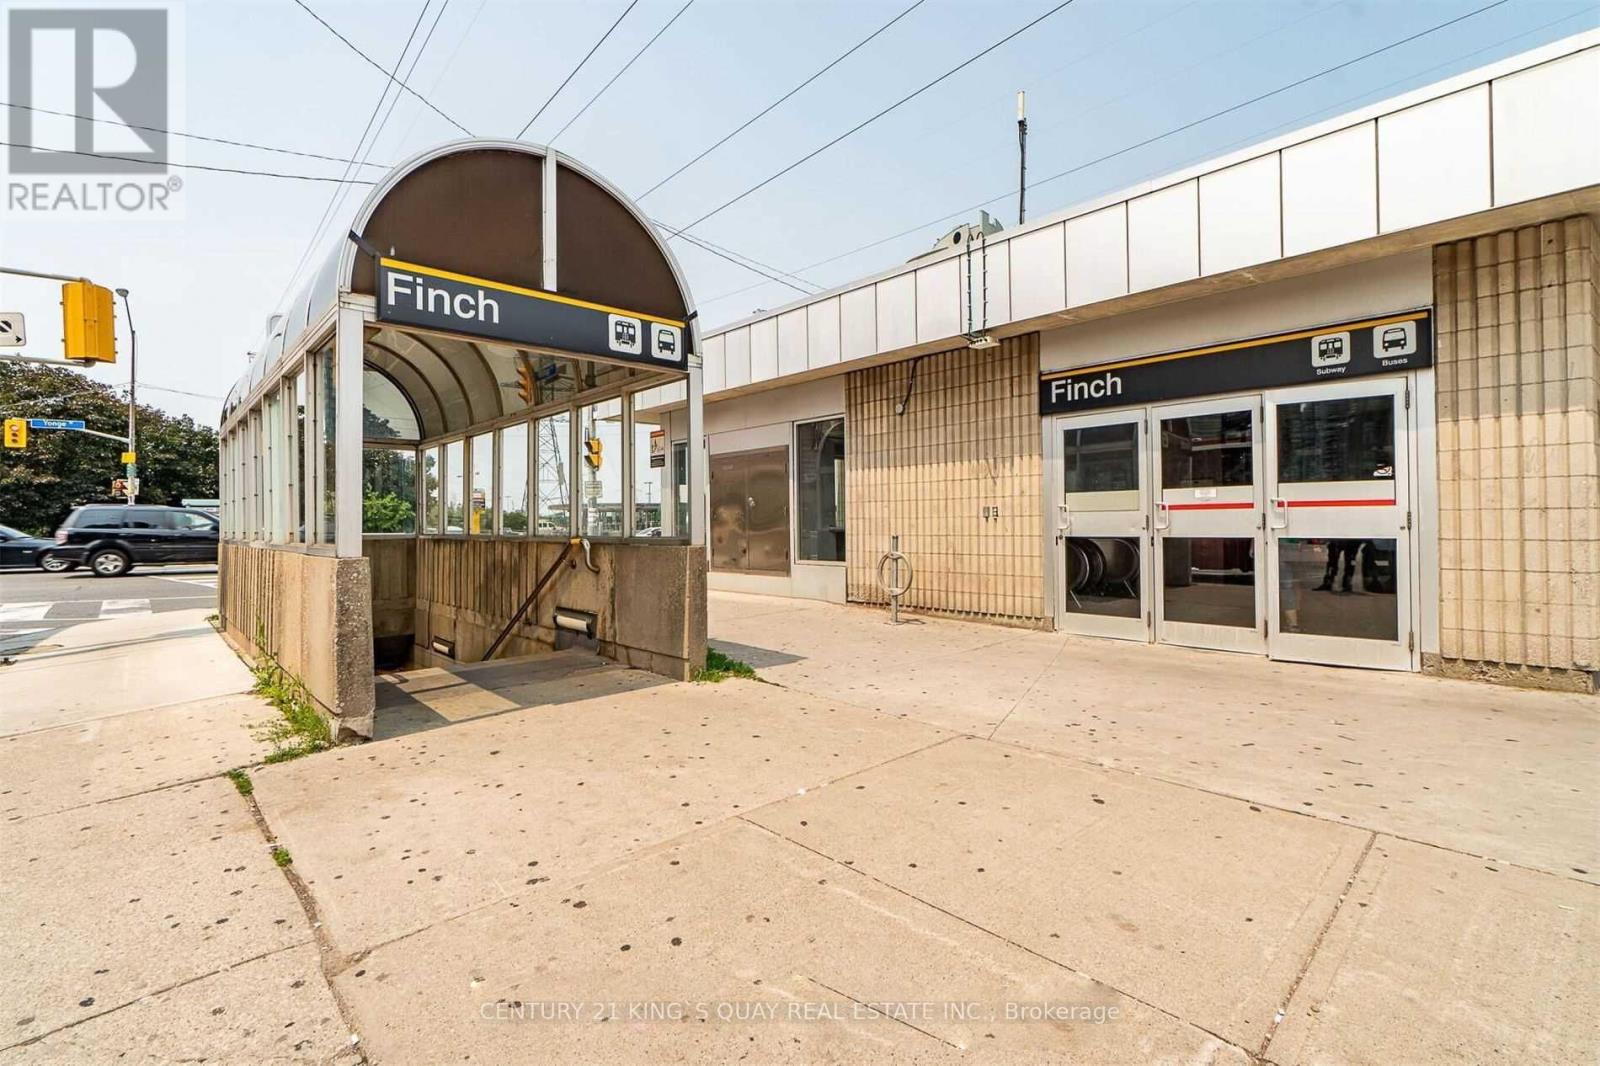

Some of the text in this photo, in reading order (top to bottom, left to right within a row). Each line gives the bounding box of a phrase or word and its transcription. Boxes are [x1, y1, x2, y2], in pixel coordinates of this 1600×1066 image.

[387, 271, 500, 324] Finch
[1382, 358, 1408, 367] Buses
[1316, 366, 1346, 376] Subway
[1050, 373, 1123, 404] Finch
[43, 419, 67, 429] Yonge
